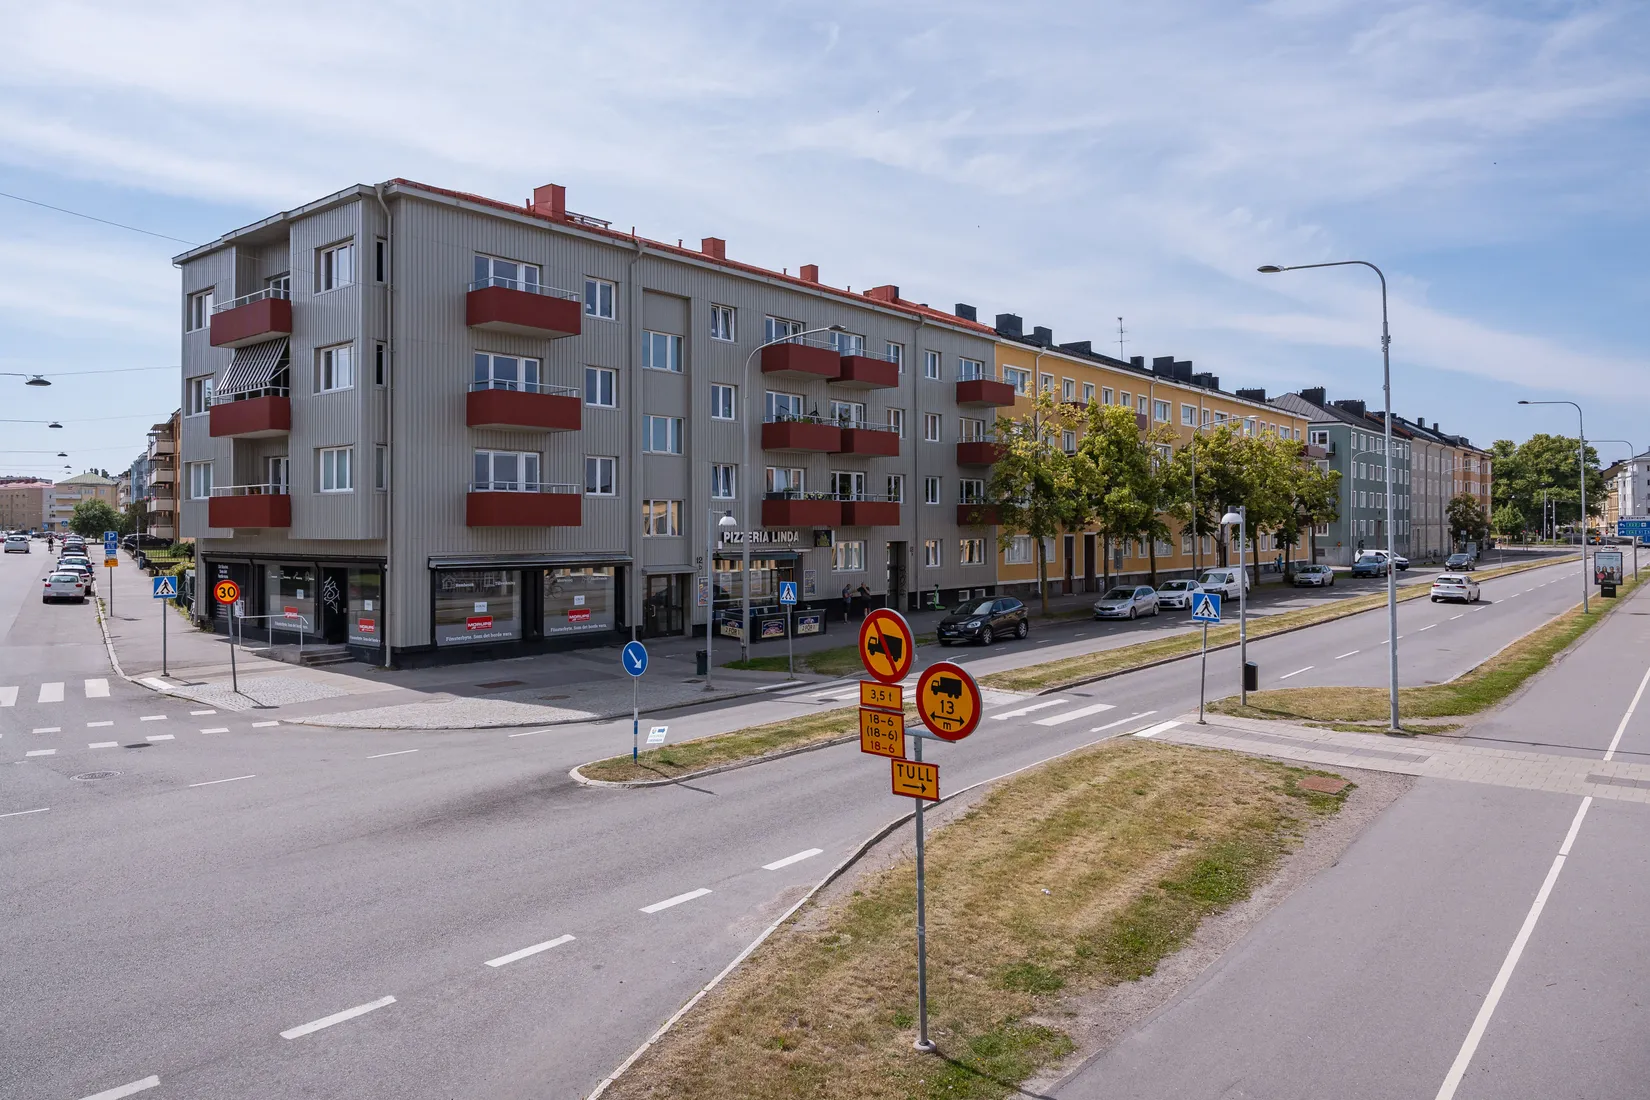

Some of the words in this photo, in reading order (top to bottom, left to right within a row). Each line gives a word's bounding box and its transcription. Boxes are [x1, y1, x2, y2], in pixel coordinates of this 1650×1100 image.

[108, 532, 116, 541] P
[772, 531, 800, 543] LINDA
[696, 556, 703, 564] 12
[218, 586, 237, 599] 30
[871, 689, 885, 702] 3,5
[888, 691, 893, 702] t
[940, 700, 955, 715] 13
[869, 714, 894, 727] 18-6
[943, 721, 952, 730] m
[866, 726, 898, 742] (18-6)
[870, 741, 895, 754] 18-6
[897, 763, 933, 782] TULL
